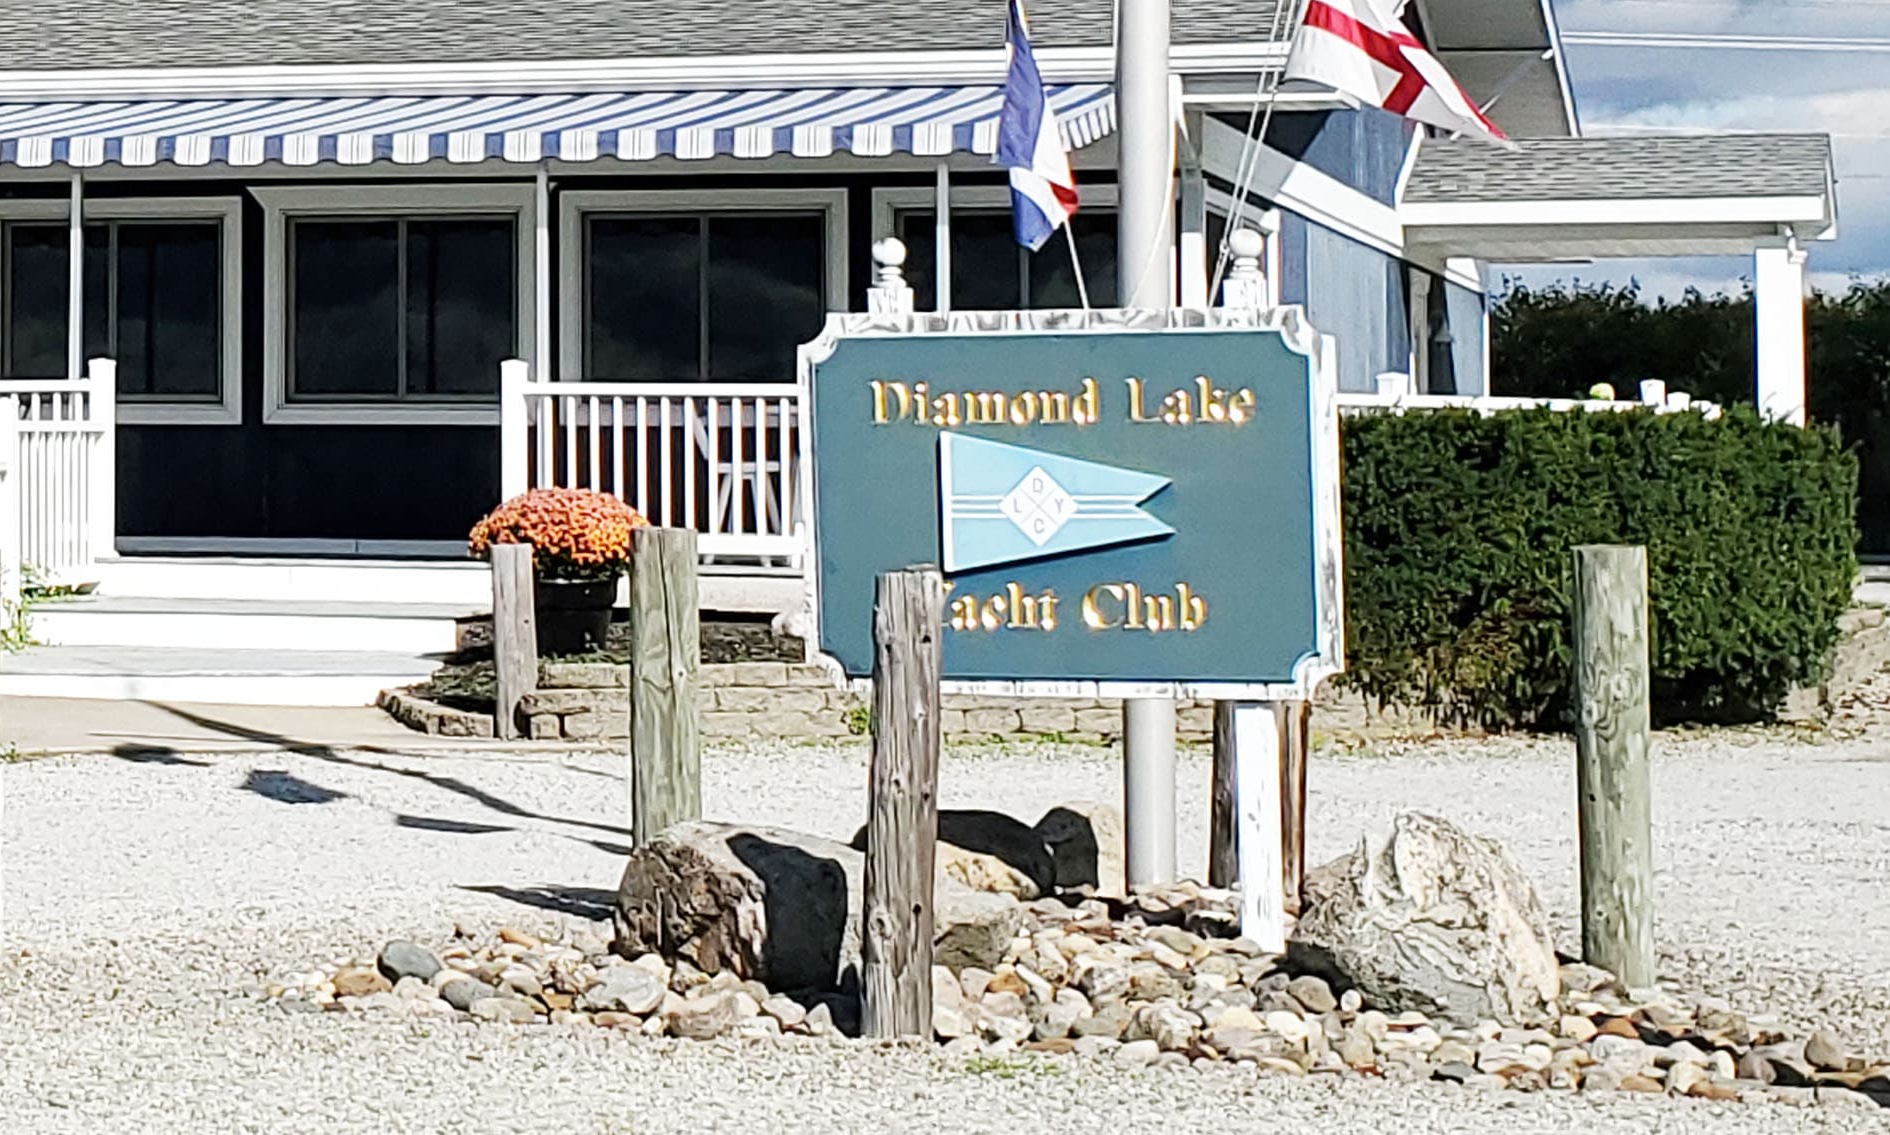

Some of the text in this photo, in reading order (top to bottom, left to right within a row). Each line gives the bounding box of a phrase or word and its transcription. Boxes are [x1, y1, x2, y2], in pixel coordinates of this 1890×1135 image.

[870, 375, 1257, 427] Diamond Lake
[1032, 477, 1044, 494] D
[1013, 497, 1064, 514] L Y
[1033, 517, 1045, 534] C
[1081, 580, 1208, 631] Club
